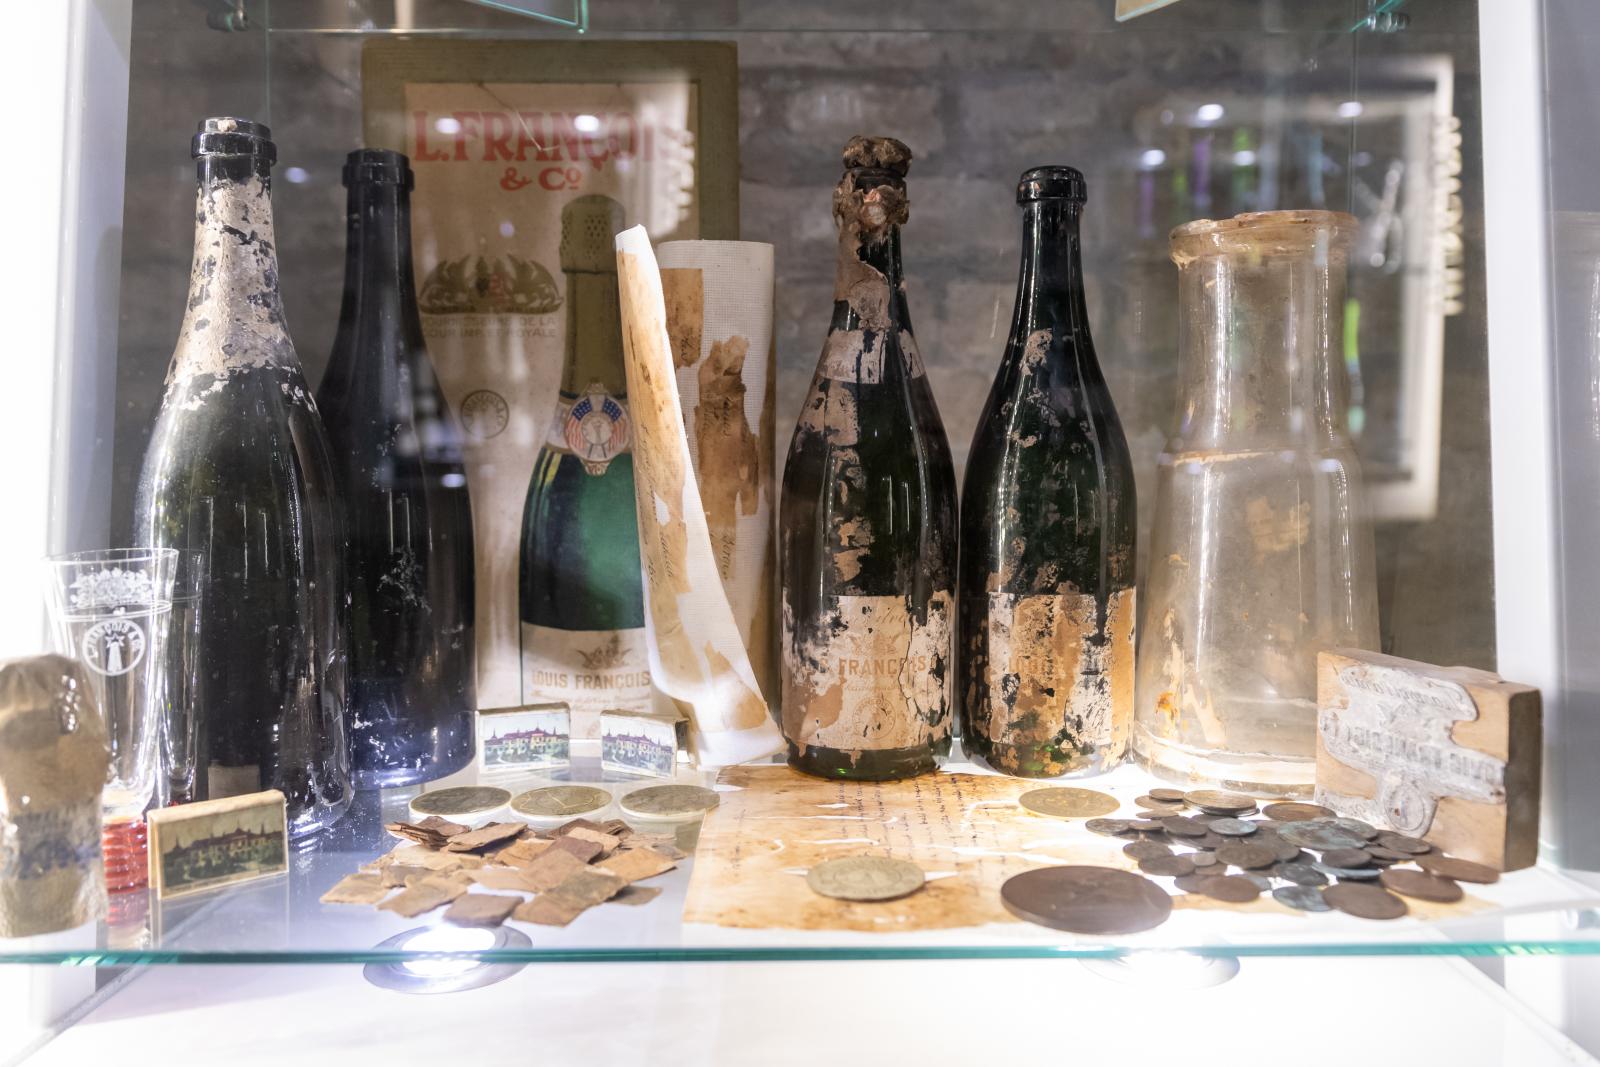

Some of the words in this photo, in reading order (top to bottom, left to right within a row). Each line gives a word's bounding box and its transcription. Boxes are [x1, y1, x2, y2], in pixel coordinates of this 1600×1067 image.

[500, 166, 532, 191] &
[531, 670, 569, 688] LOUIS
[575, 670, 651, 692] FRANÇOIS
